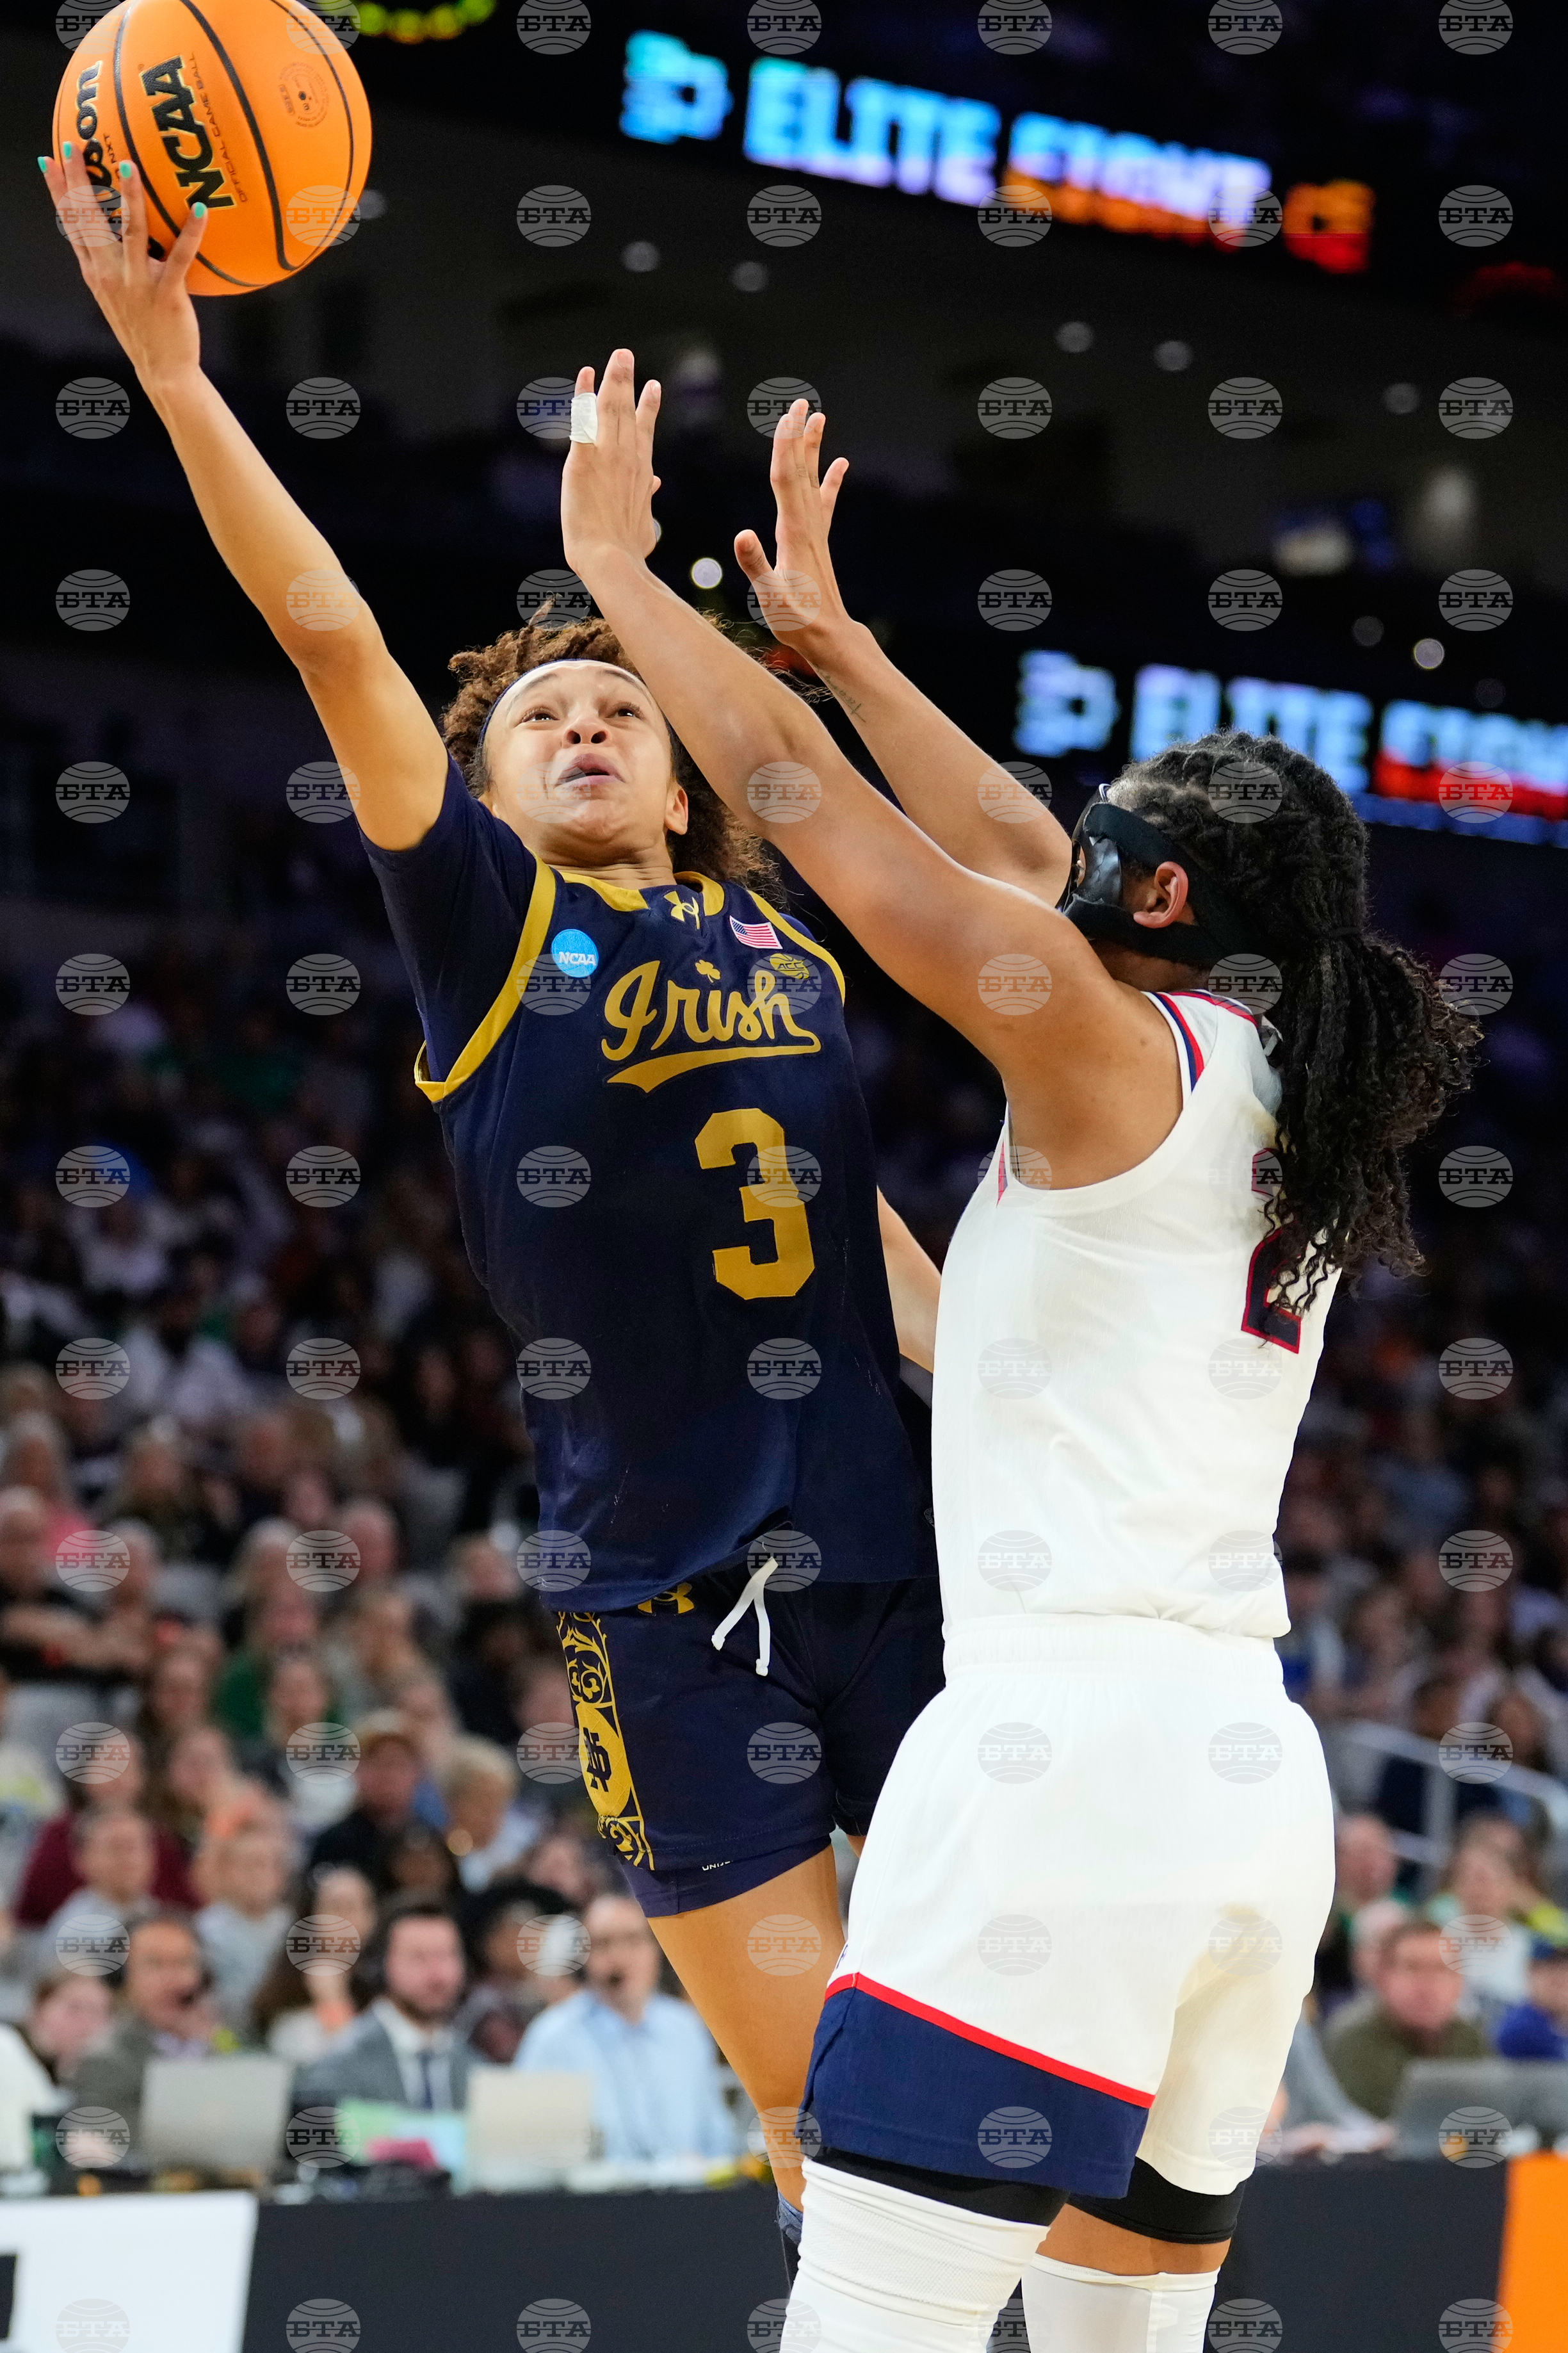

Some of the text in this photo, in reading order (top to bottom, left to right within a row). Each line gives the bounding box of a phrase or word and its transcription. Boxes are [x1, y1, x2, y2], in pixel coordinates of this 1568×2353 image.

[138, 54, 237, 210] NCAA
[188, 51, 248, 203] OFFICIAL GAME BALL
[743, 56, 1001, 208] ELITE
[558, 951, 597, 966] NCAA
[601, 960, 821, 1066] Irish
[777, 961, 805, 970] ACC
[695, 1108, 816, 1301] 3
